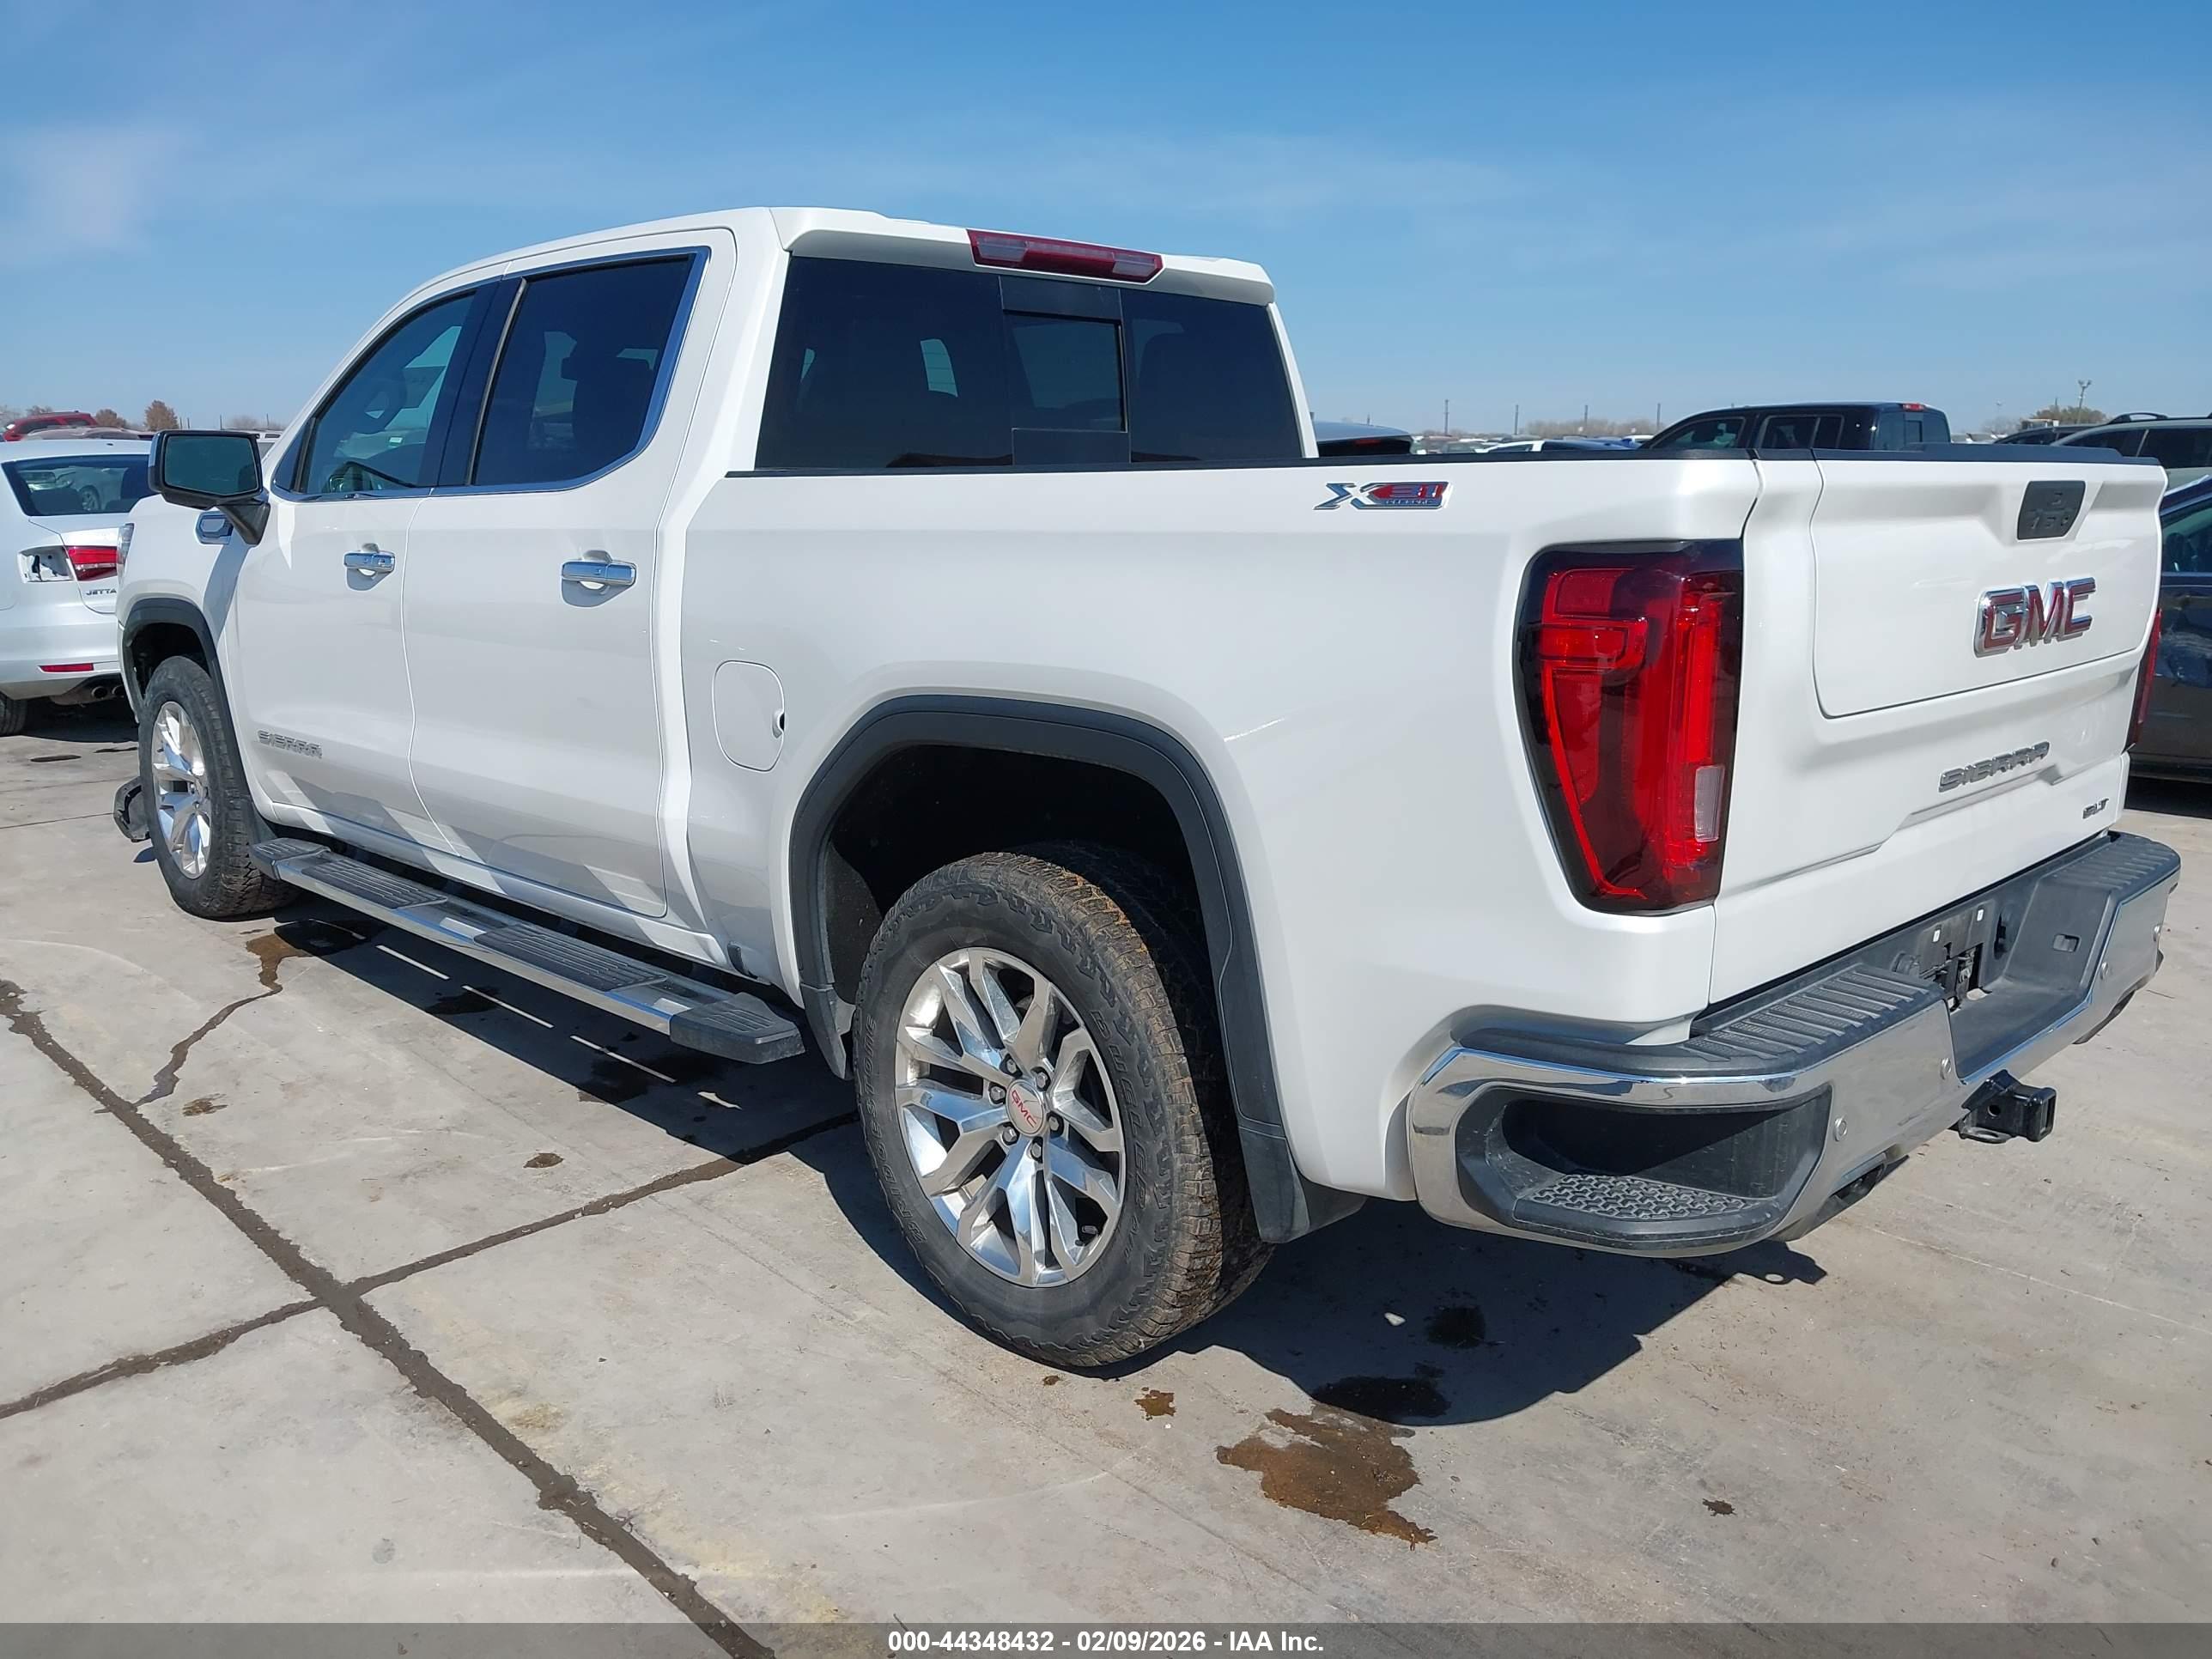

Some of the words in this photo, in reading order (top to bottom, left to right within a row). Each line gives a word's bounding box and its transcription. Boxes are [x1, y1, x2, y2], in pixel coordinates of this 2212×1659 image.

[1974, 576, 2097, 658] GMC
[257, 729, 323, 760] SIERRA
[1938, 741, 2051, 793] SIERRA
[864, 1016, 927, 1242] BRIDGESTONE
[1012, 1089, 1037, 1129] GMC
[1090, 1009, 1146, 1210] DUELER
